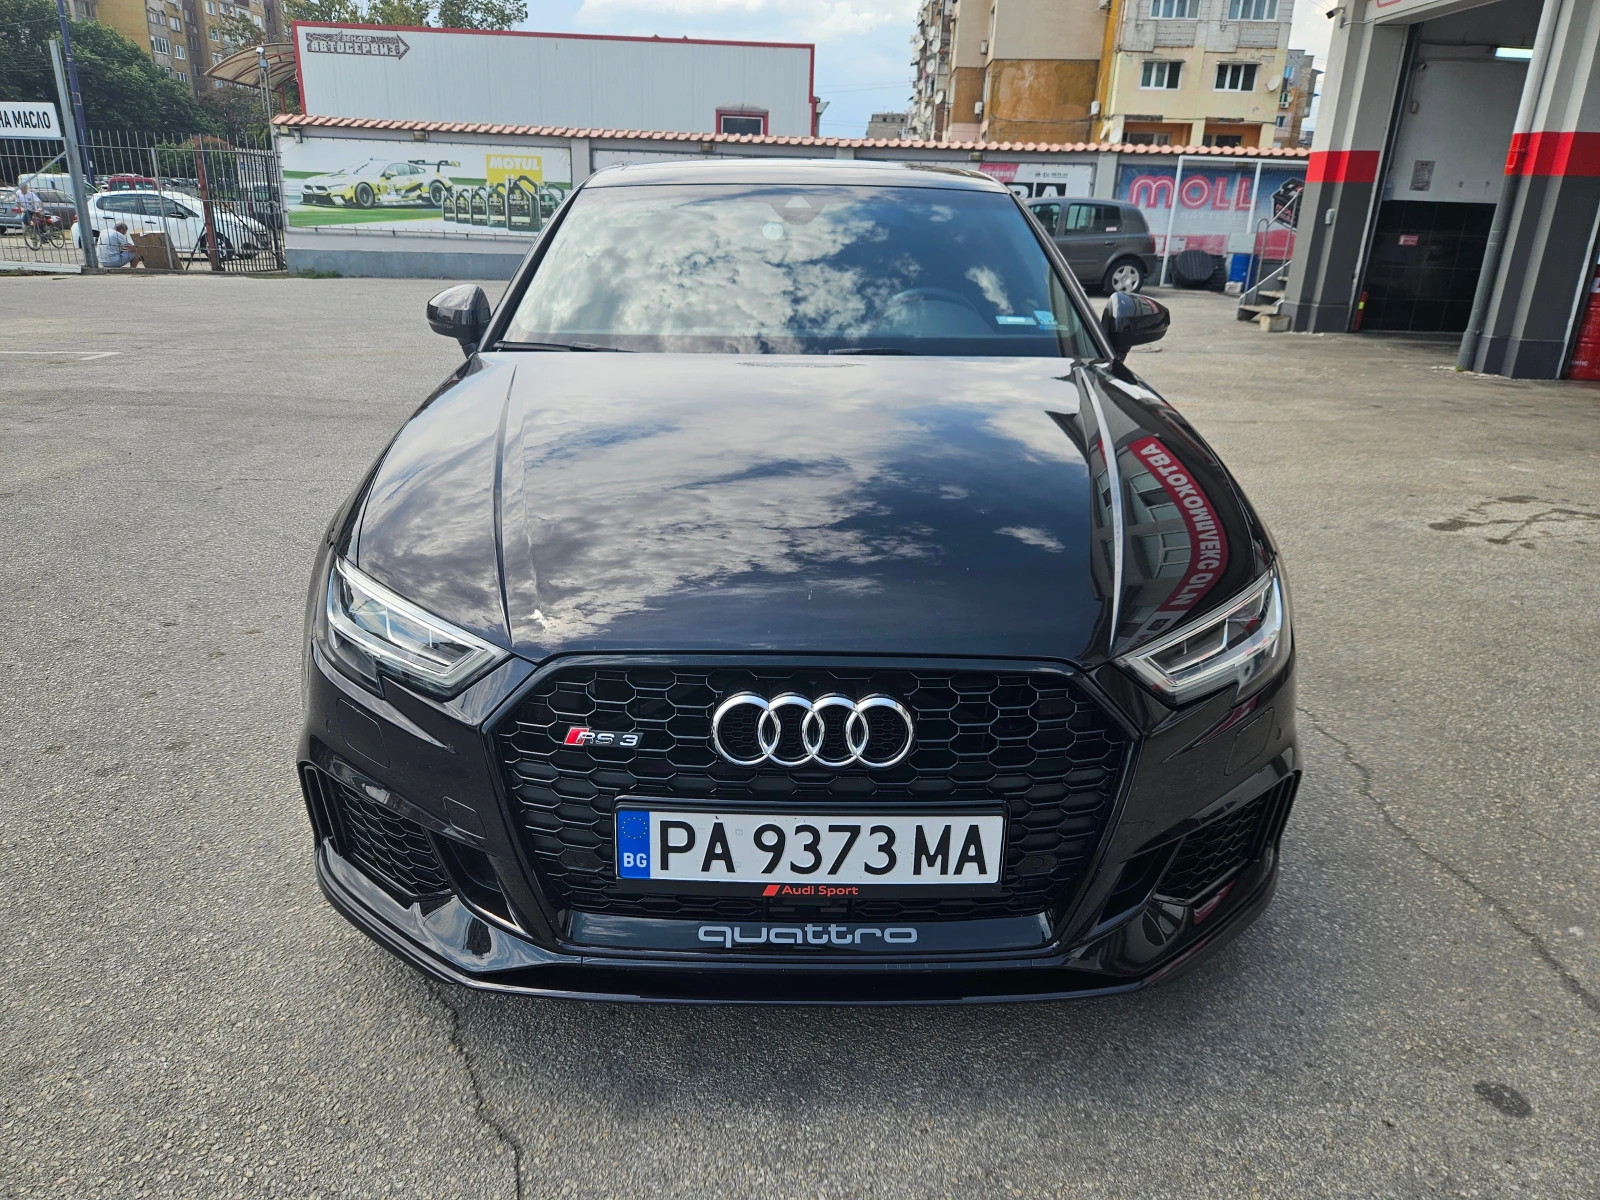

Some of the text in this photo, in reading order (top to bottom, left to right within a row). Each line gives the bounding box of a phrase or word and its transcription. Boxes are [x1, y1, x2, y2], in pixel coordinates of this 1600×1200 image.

[310, 40, 398, 56] АВТОСЕРВИЗ
[11, 110, 51, 129] МАСЛО
[489, 156, 540, 171] MOTUL
[576, 731, 639, 746] RS 3
[659, 820, 988, 876] PA 9373 MA
[623, 852, 648, 868] BG
[781, 885, 859, 897] Audi Sport
[697, 923, 918, 948] quattro
